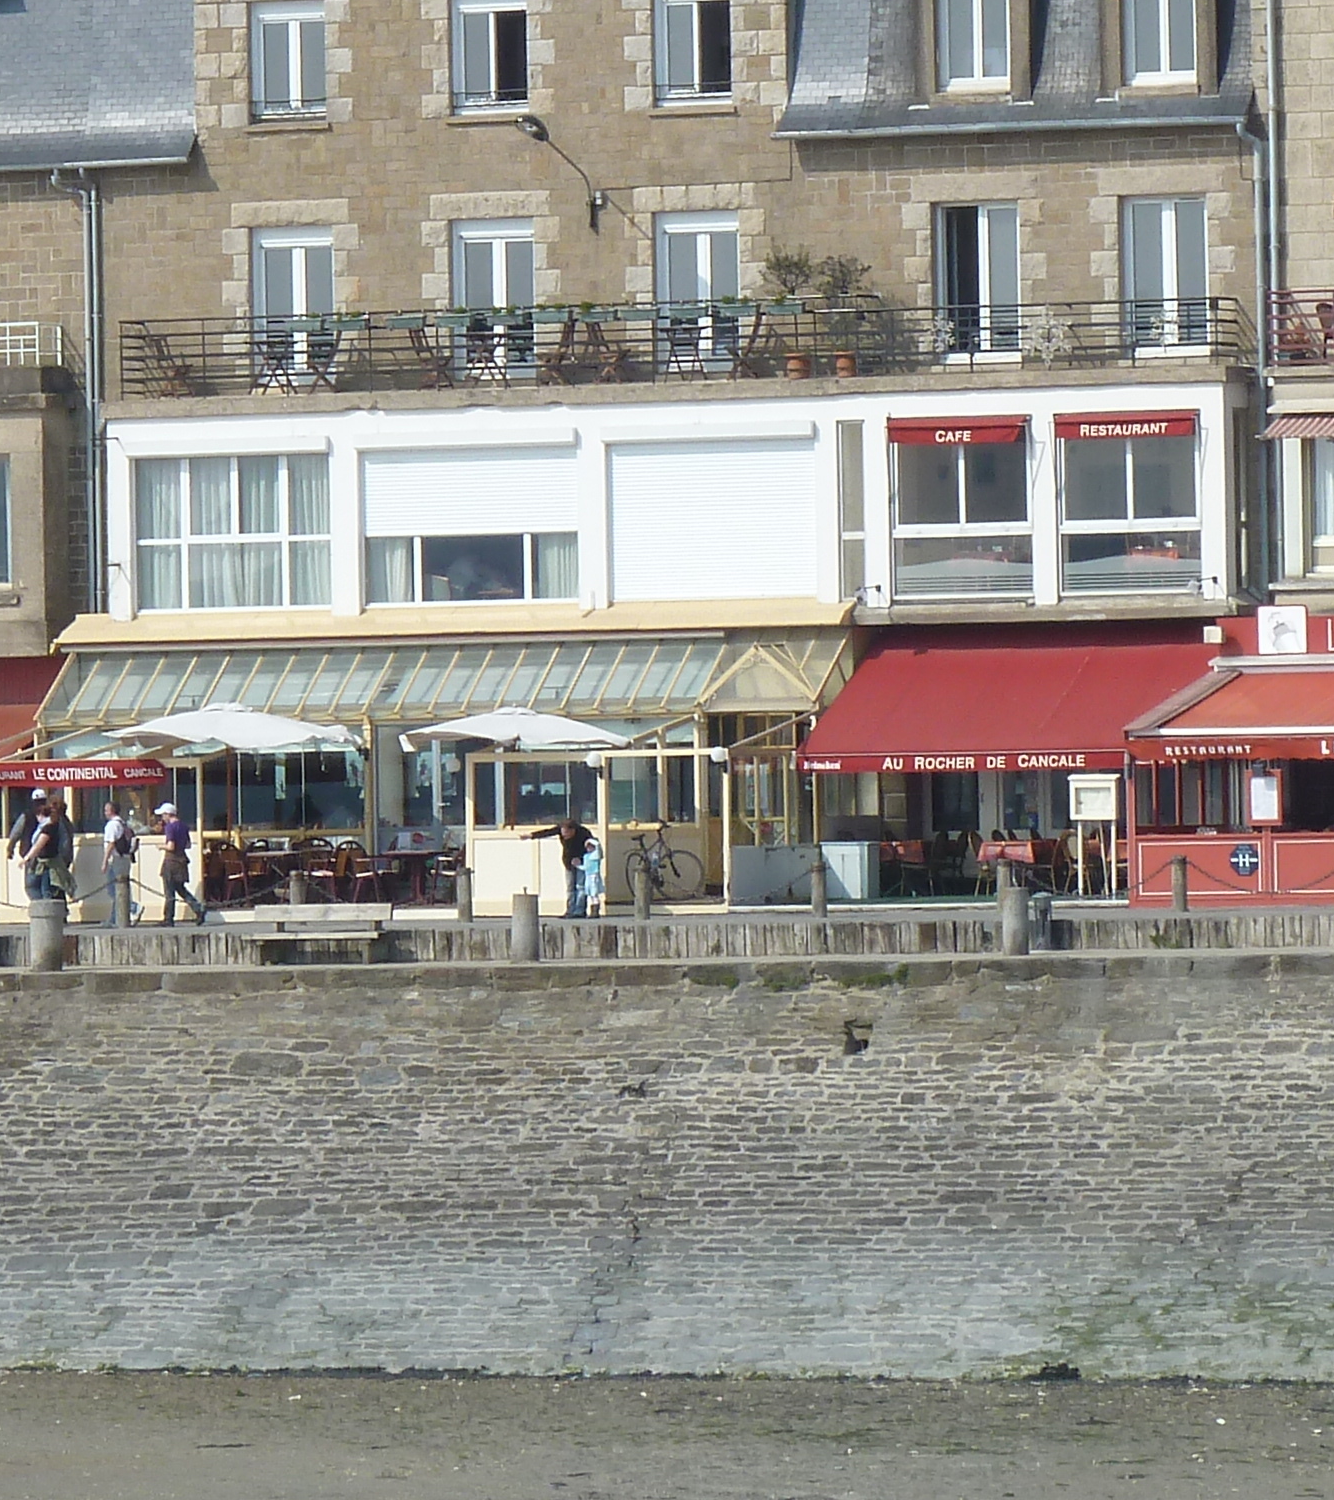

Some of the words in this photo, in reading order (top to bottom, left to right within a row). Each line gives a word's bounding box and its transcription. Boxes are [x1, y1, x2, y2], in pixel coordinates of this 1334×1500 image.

[935, 430, 972, 443] CAFE
[1079, 422, 1168, 437] RESTAURANT
[1165, 745, 1252, 756] RESTAURANT
[882, 756, 903, 770] AU
[914, 755, 975, 770] ROCHER
[986, 756, 1006, 769] DE
[1017, 754, 1085, 768] CANCALE
[33, 768, 46, 780] LE
[47, 766, 118, 781] CONTINENTAL
[123, 767, 164, 778] CANCALE
